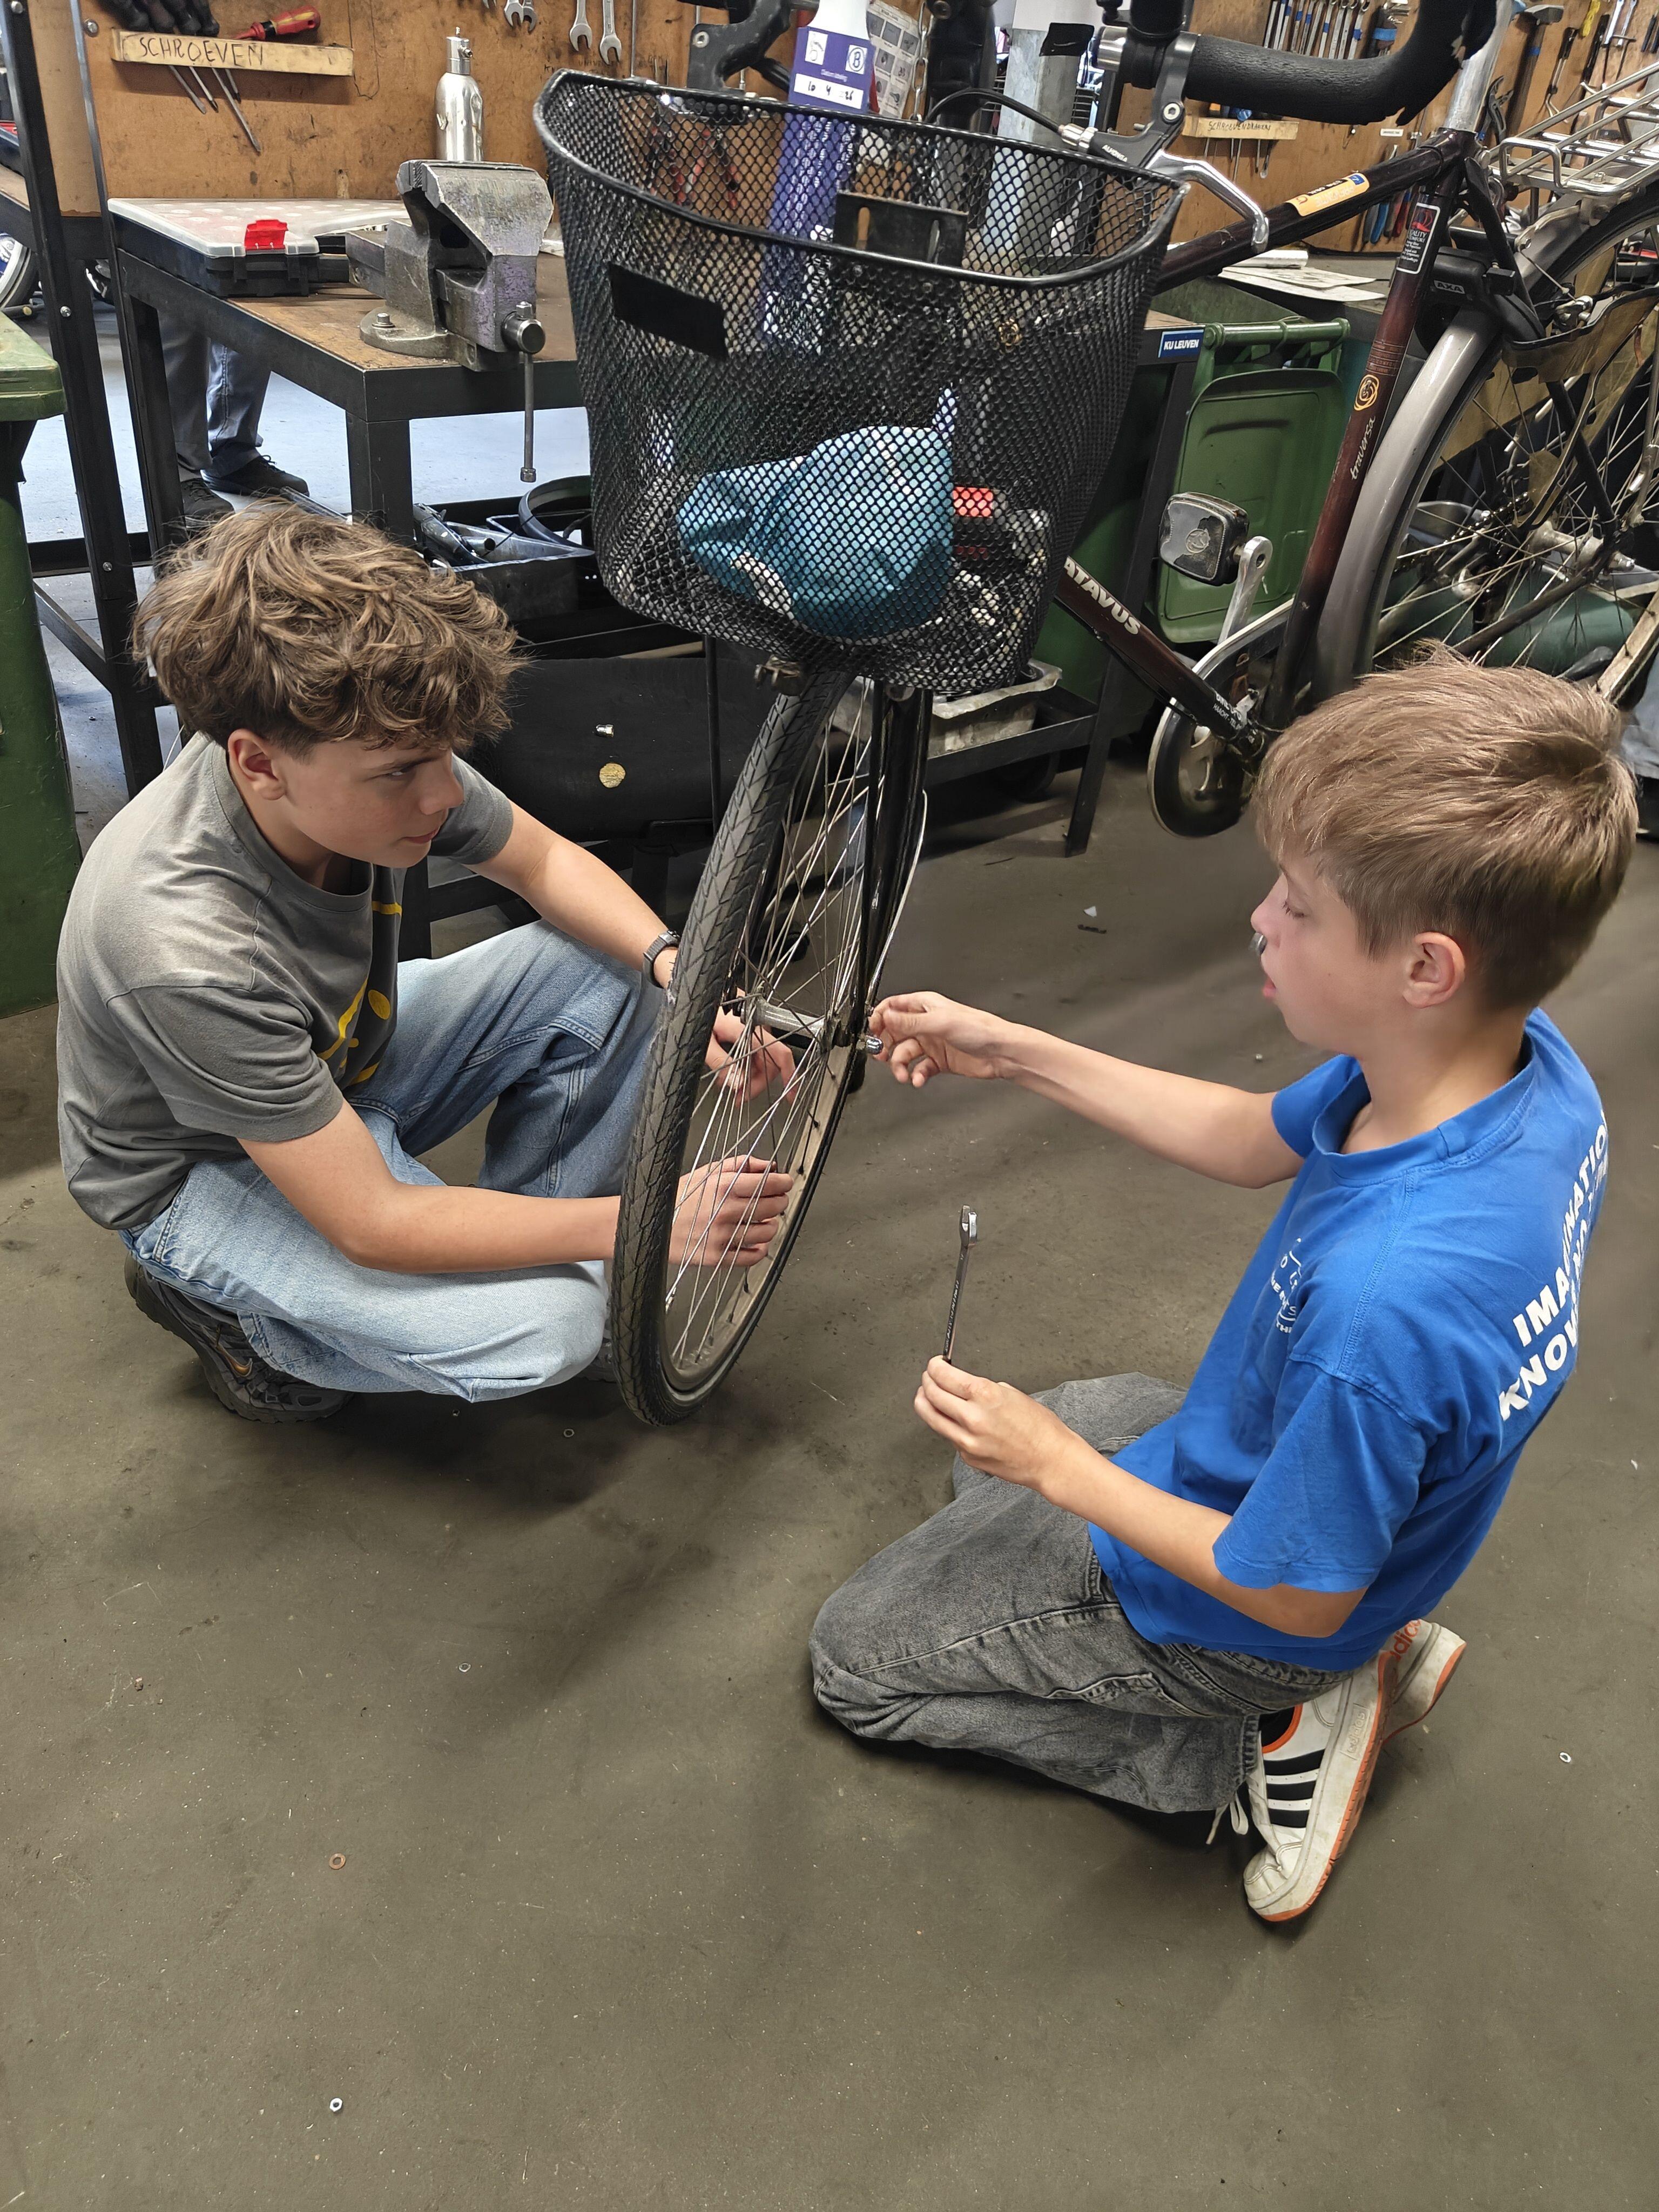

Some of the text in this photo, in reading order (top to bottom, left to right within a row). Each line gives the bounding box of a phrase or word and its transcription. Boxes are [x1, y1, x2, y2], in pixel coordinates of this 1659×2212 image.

[139, 37, 263, 68] SCHROEVEN
[1437, 282, 1462, 292] AXA
[1163, 339, 1199, 350] KU LEUVEN
[1350, 415, 1376, 480] traversa
